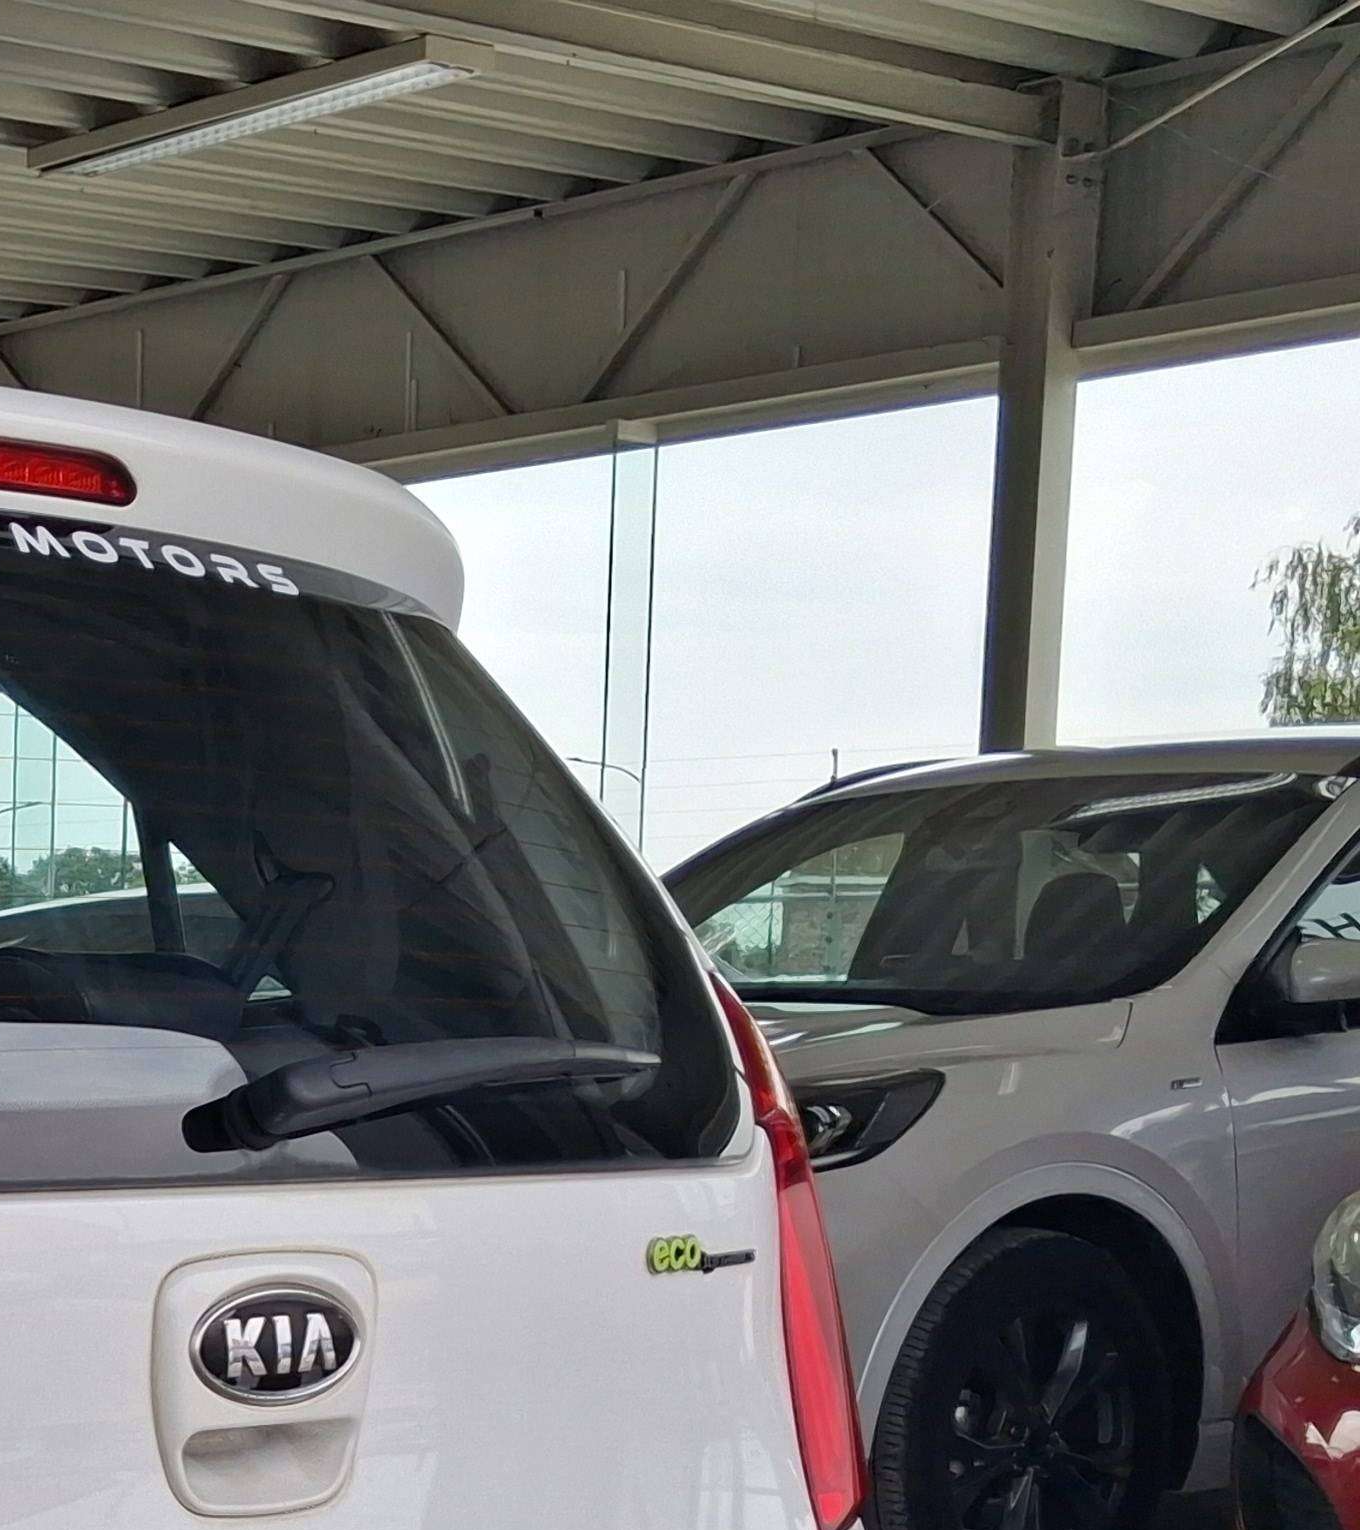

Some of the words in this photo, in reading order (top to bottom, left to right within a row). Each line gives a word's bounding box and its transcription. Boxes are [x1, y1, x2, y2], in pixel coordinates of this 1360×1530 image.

[8, 521, 300, 597] MOTORS
[650, 1236, 702, 1272] eco
[223, 1312, 338, 1379] KIA
